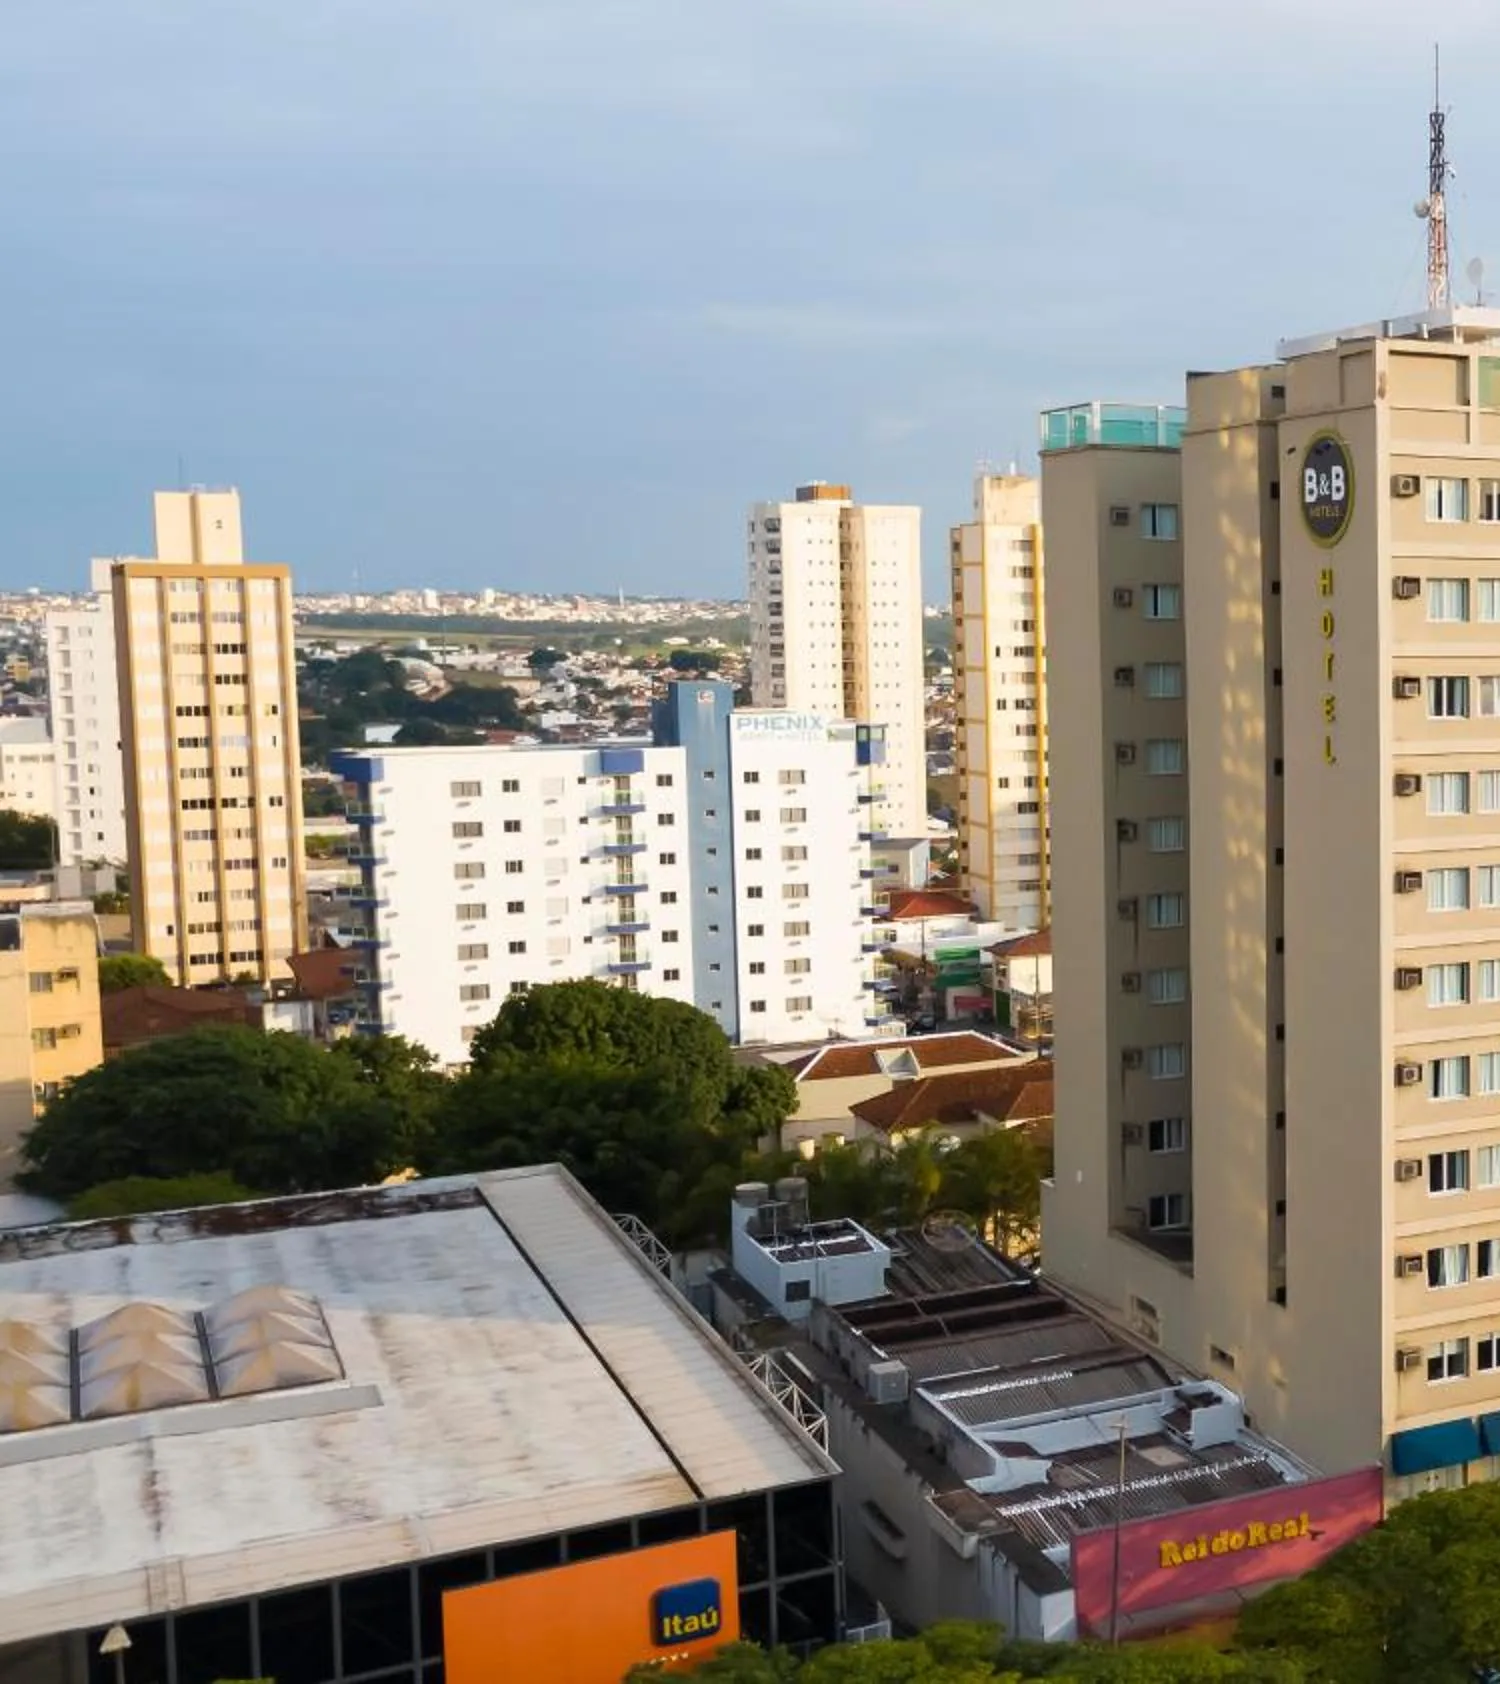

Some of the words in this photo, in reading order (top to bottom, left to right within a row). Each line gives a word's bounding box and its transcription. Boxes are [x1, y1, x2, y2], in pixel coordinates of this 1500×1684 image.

[1304, 465, 1345, 503] B&B
[1318, 568, 1336, 764] HOTEL
[736, 715, 824, 731] PHENIX
[662, 1605, 719, 1638] Itaú
